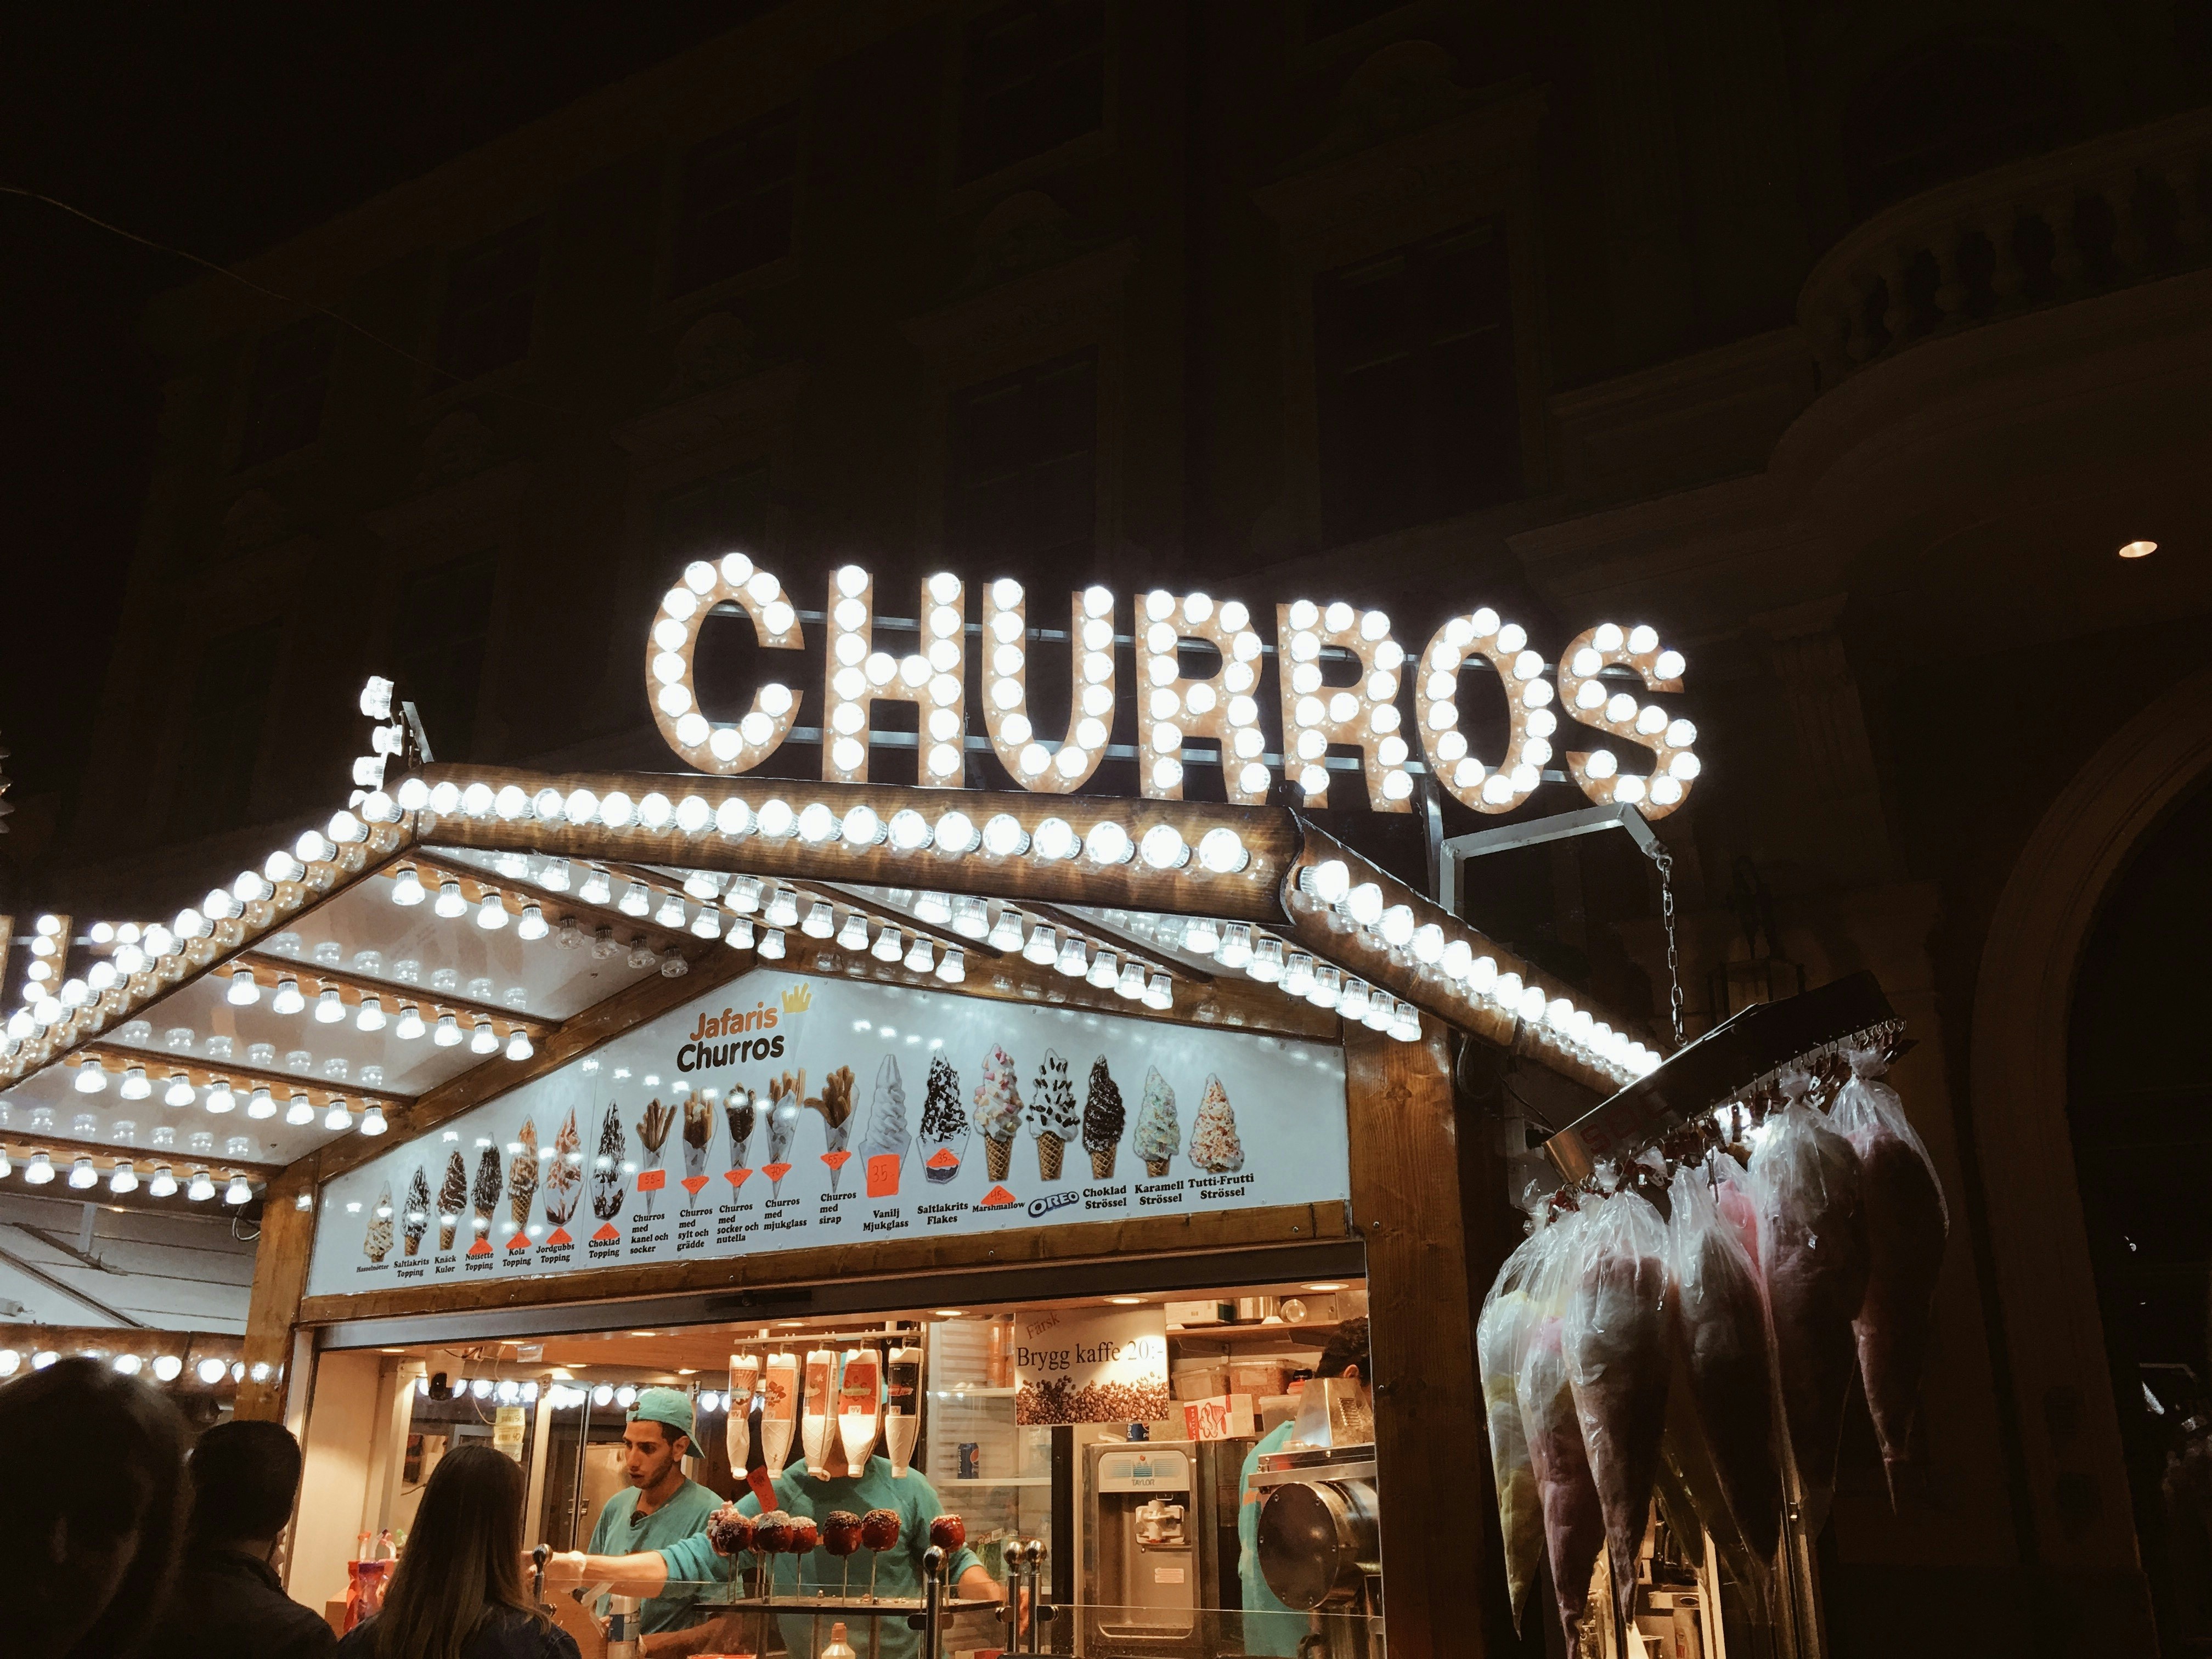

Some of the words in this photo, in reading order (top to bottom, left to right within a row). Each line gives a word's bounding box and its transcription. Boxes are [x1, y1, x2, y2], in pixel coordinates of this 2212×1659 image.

[646, 552, 1701, 821] CHURROS
[690, 1001, 778, 1042] Jafaris
[676, 1035, 785, 1073] Churros
[1188, 1172, 1255, 1188] Tutti-Frutti
[1082, 1184, 1127, 1198] Choklad
[1135, 1180, 1184, 1194] Karamell
[820, 1191, 857, 1202] Churros
[1200, 1187, 1245, 1199] Strössel
[765, 1197, 800, 1208] Churros
[1028, 1191, 1080, 1218] OREO
[1085, 1197, 1127, 1210] Strössel
[1139, 1193, 1182, 1205] Strössel
[679, 1207, 713, 1218] Churros
[719, 1203, 753, 1214] Churros
[820, 1204, 838, 1214] med
[917, 1201, 969, 1215] Saltlakrits
[972, 1201, 1026, 1213] Marshmallow
[633, 1212, 665, 1223] Churros
[764, 1209, 782, 1219] med
[873, 1207, 900, 1219] Vanilj
[679, 1219, 696, 1229] med
[718, 1214, 736, 1224] med
[819, 1215, 842, 1225] sirap
[927, 1215, 958, 1225] Flakes
[631, 1223, 648, 1233] med
[716, 1224, 743, 1235] socker
[744, 1222, 759, 1231] och
[764, 1218, 808, 1232] mjukglass
[862, 1220, 909, 1233] Mjukglass
[631, 1234, 653, 1244] kanel
[654, 1233, 669, 1241] och
[678, 1229, 693, 1240] sylt
[694, 1228, 709, 1237] och
[716, 1233, 746, 1244] nutella
[588, 1237, 620, 1248] Choklad
[676, 1240, 705, 1252] grädde
[509, 1247, 526, 1256] Kola
[535, 1243, 575, 1254] Jordgubbs
[589, 1248, 620, 1259] Topping
[630, 1245, 656, 1254] socker
[393, 1257, 430, 1268] Saltlakrits
[434, 1255, 457, 1264] Knäck
[503, 1257, 532, 1267] Topping
[540, 1254, 571, 1263] Topping
[435, 1266, 455, 1274] Kulor
[465, 1262, 494, 1272] Topping
[397, 1268, 424, 1278] Topping
[1025, 1311, 1061, 1340] Färsk
[1017, 1347, 1070, 1372] Brygg
[1075, 1341, 1121, 1364] kaffe
